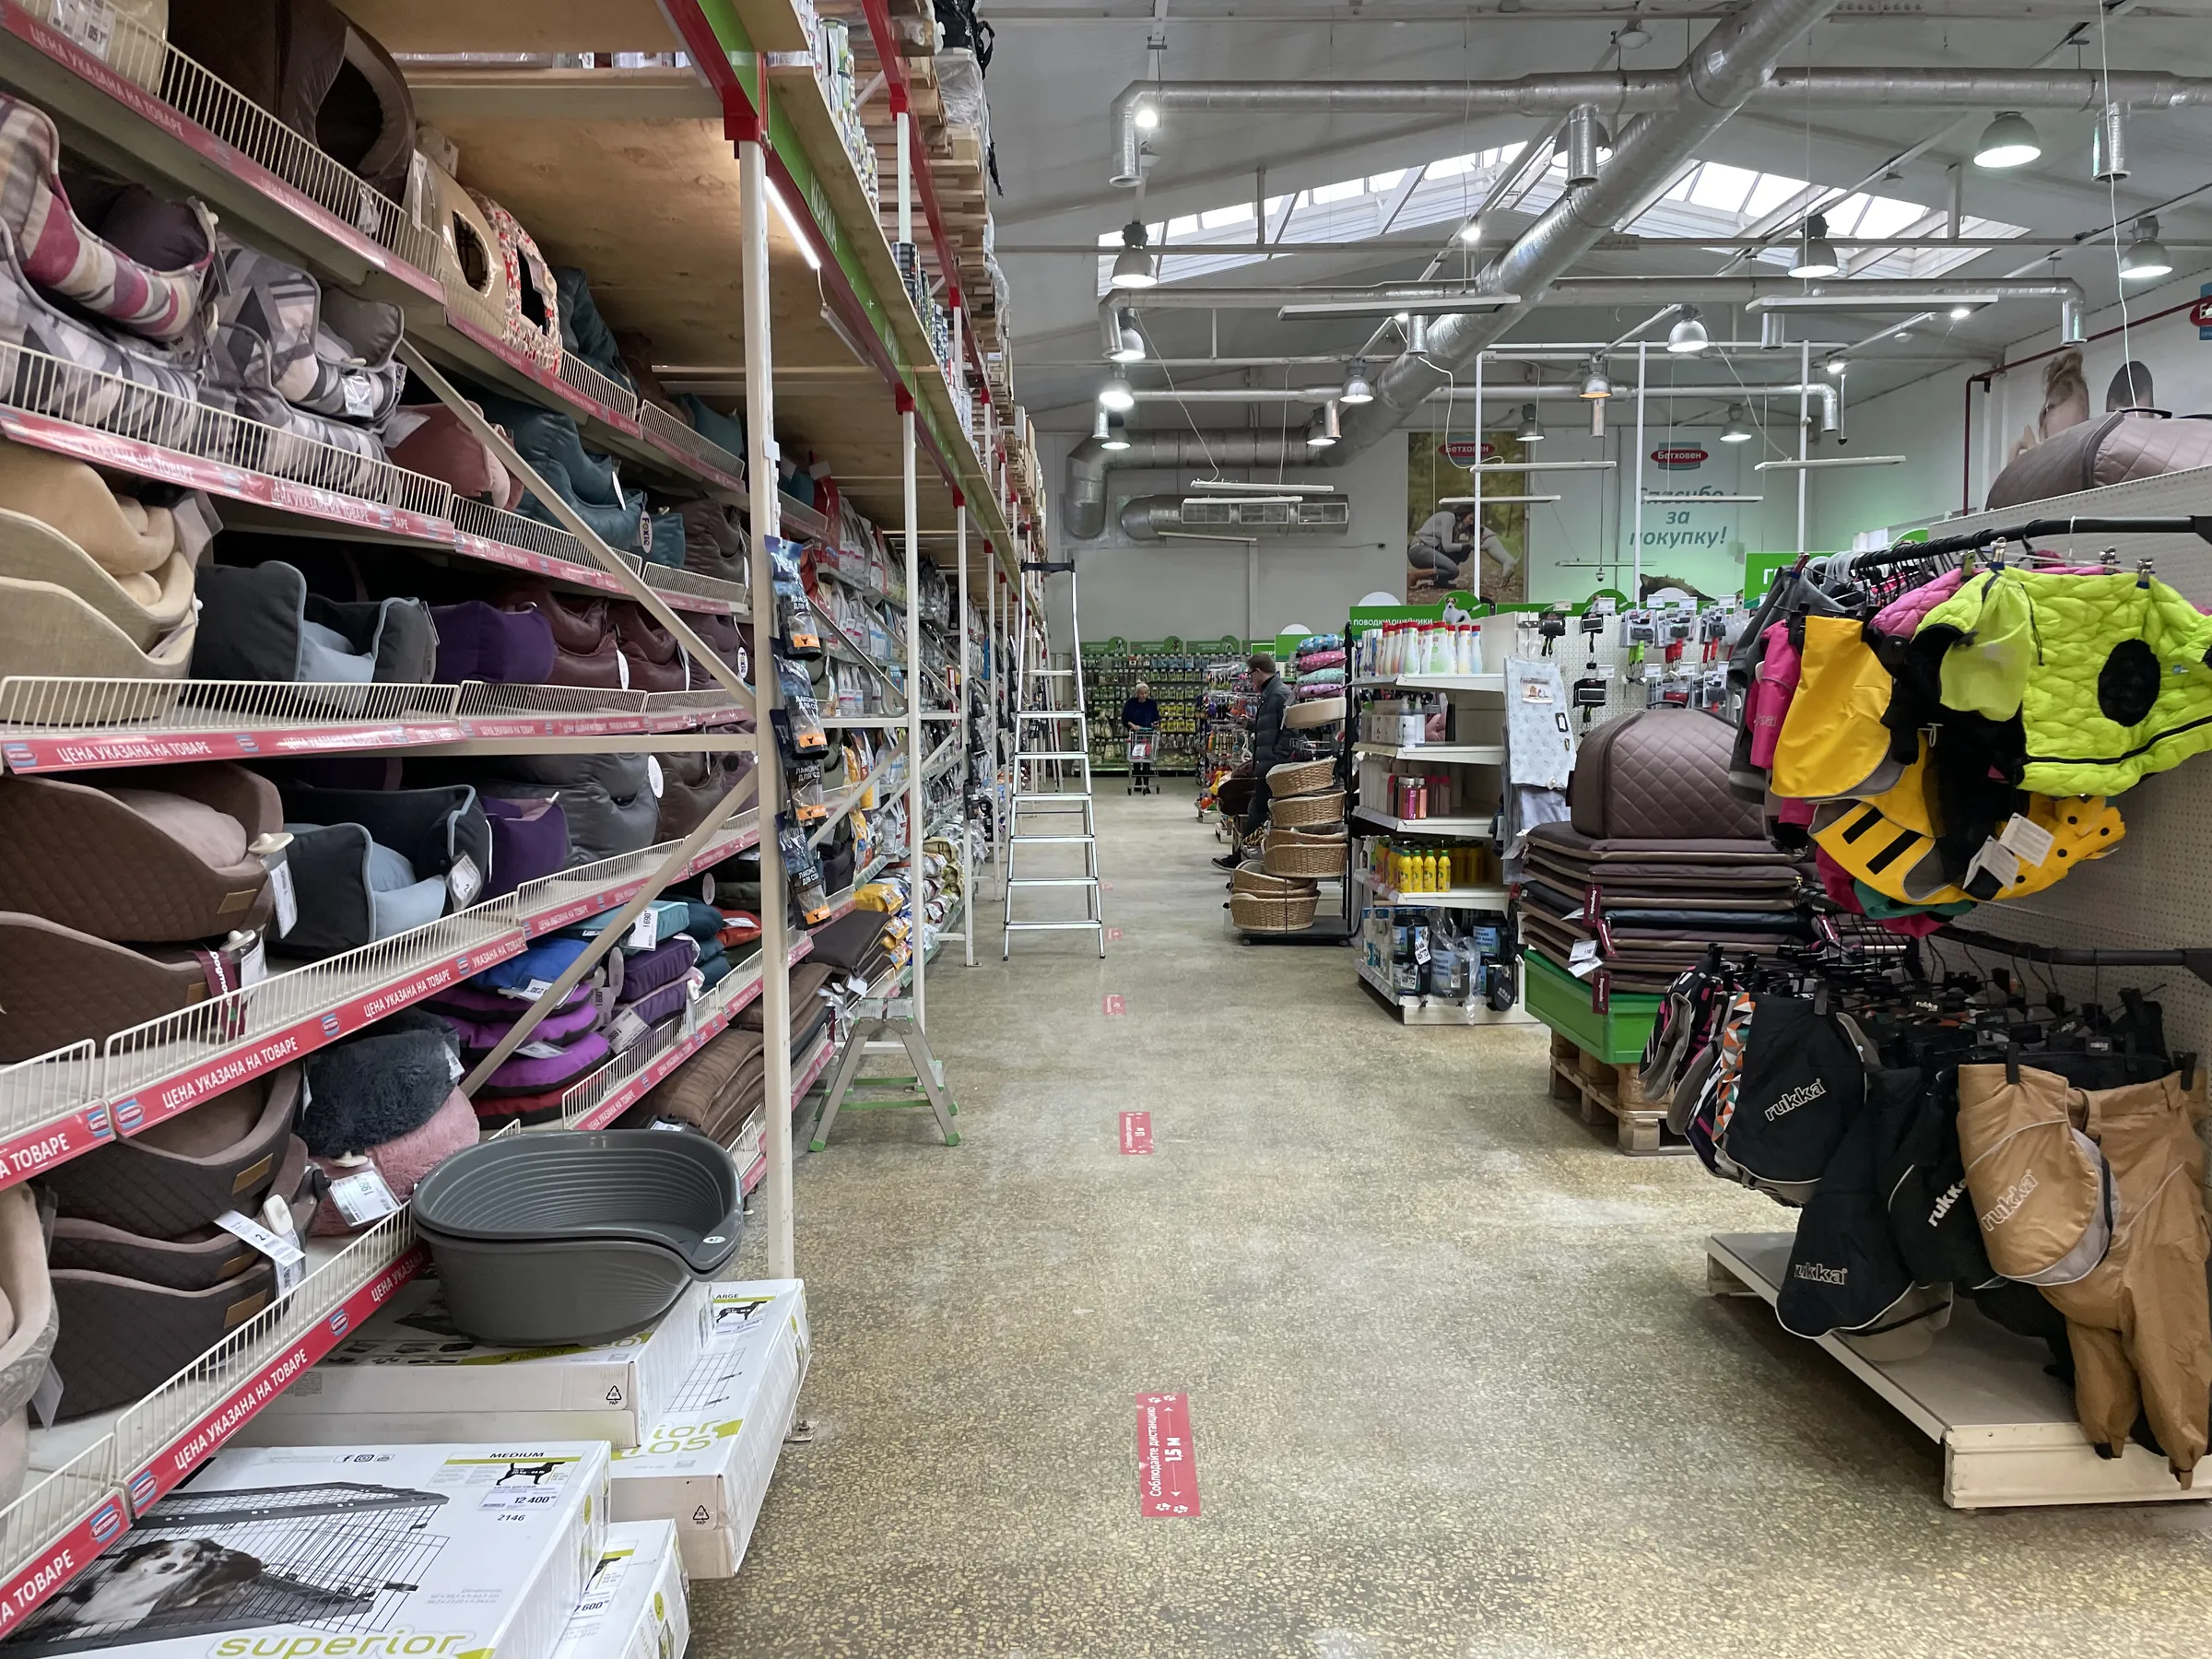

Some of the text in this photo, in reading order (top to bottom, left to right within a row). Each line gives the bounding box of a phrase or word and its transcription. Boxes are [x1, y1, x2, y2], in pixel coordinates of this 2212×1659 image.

[1657, 451, 1701, 460] Бетховен
[1665, 511, 1690, 524] за
[56, 741, 212, 765] ЦЕНА УКАЗАНА НА ТОВАРЕ
[472, 948, 498, 969] УКАЗАНА
[505, 935, 525, 954] ТОВАРЕ
[363, 969, 452, 1018] ЦЕНА УКАЗАНА НА ТОВАРЕ
[162, 1036, 299, 1111] ЦЕНА УКАЗАНА НА ТОВАРЕ
[1764, 1077, 1827, 1122] rukka
[0, 1133, 70, 1180] А ТОВАРЕ
[1982, 1169, 2039, 1232] rukka
[174, 1348, 308, 1471] ЦЕНА УКАЗАНА НА ТОВАРЕ
[1147, 1406, 1162, 1497] Соблюдайте дистанцию
[0, 1548, 75, 1627] А ТОВАРЕ
[216, 1630, 466, 1659] superior
